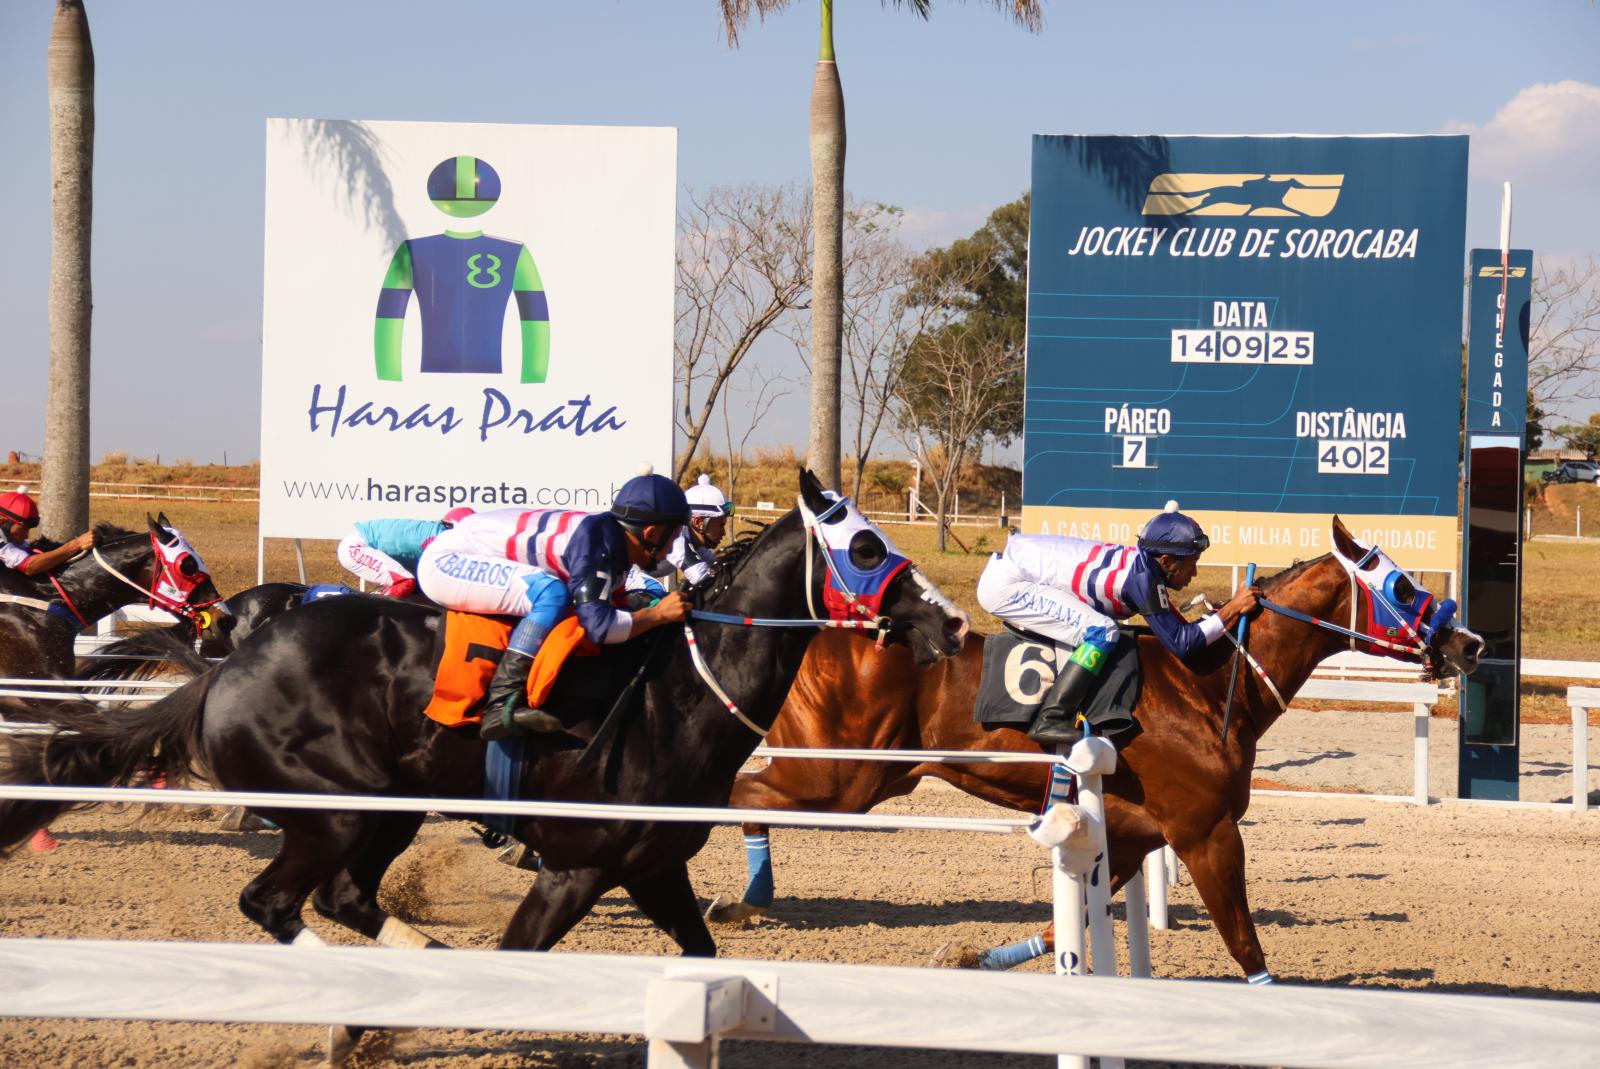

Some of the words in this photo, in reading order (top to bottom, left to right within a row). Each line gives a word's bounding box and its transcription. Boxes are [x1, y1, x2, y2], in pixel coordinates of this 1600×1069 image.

[1068, 226, 1168, 256] JOCKEY
[1169, 227, 1236, 257] CLUB
[1238, 228, 1280, 258] DE
[1279, 228, 1419, 258] SOROCABA
[466, 252, 501, 289] 8
[1213, 301, 1268, 328] DATA
[308, 383, 463, 438] Haras
[478, 387, 627, 442] Prata
[1104, 403, 1171, 434] PÁREO
[1296, 407, 1407, 438] DISTÂNCIA
[1127, 440, 1143, 463] 7
[283, 477, 622, 508] www.harasprata.com.b
[1041, 520, 1050, 535] A
[1057, 521, 1101, 541] CASA
[1109, 523, 1130, 542] DO
[1211, 525, 1232, 544] DE
[1239, 526, 1292, 546] MILHA
[1300, 528, 1320, 547] DE
[1328, 528, 1437, 549] OCIDADE
[596, 571, 611, 600] 7
[1004, 642, 1055, 705] 6
